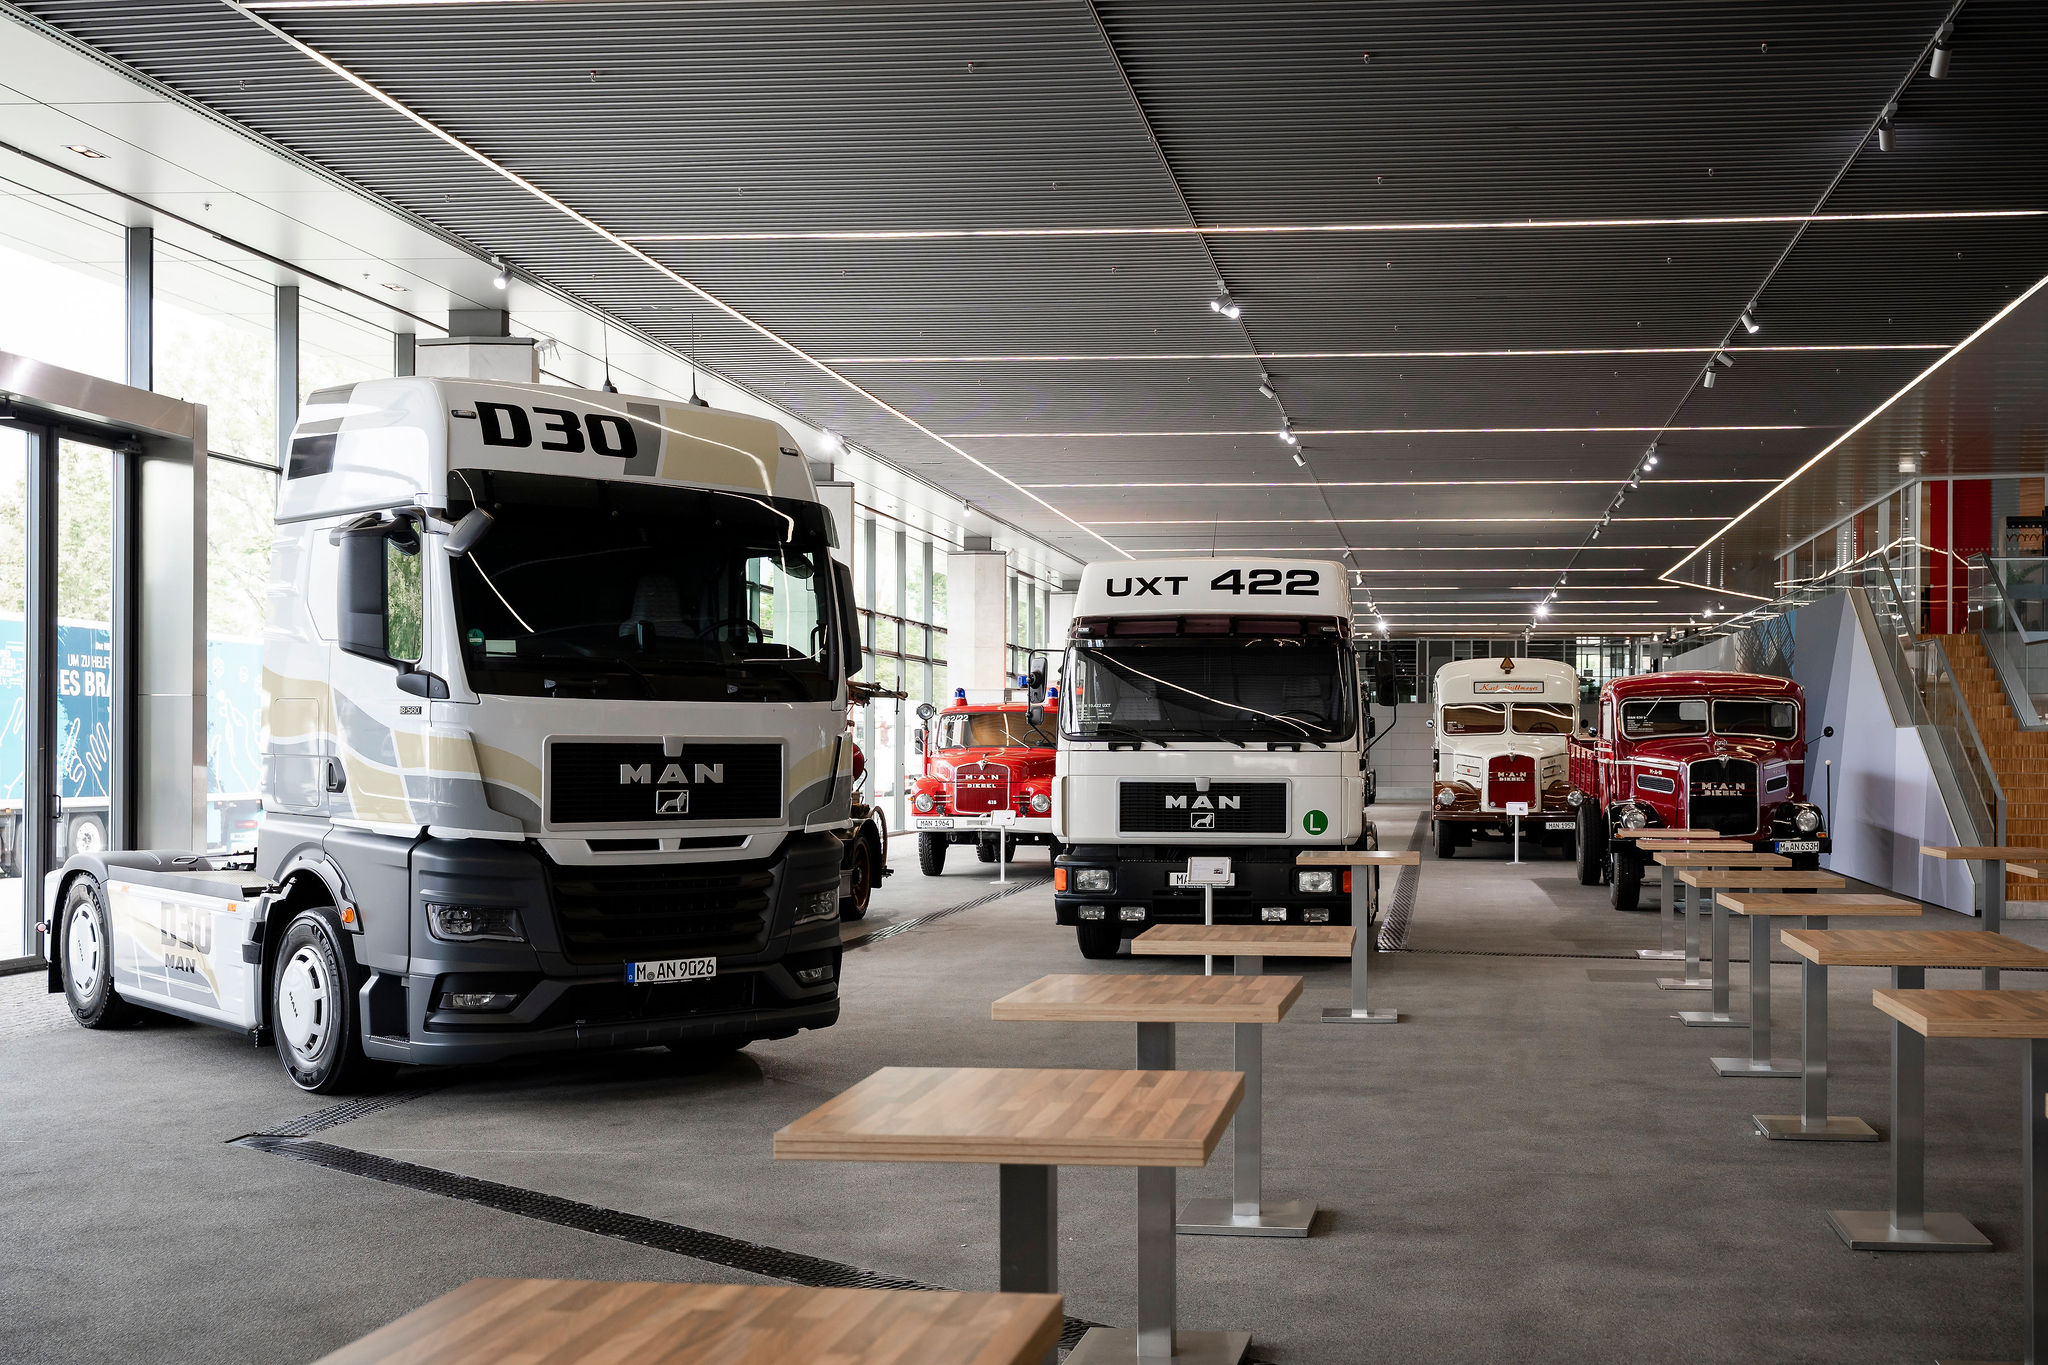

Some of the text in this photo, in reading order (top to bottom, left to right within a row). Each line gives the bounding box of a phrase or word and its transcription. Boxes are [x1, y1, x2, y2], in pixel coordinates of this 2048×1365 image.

[474, 401, 638, 458] D30
[1106, 569, 1320, 597] UXT 422
[67, 653, 79, 667] UM
[91, 655, 110, 669] HELF
[60, 669, 80, 697] ES
[620, 763, 723, 784] MAN
[1165, 795, 1241, 809] MAN
[1309, 814, 1321, 831] L
[165, 953, 195, 974] MAN
[636, 964, 646, 980] M
[657, 962, 676, 978] AN
[680, 959, 714, 977] 9026
